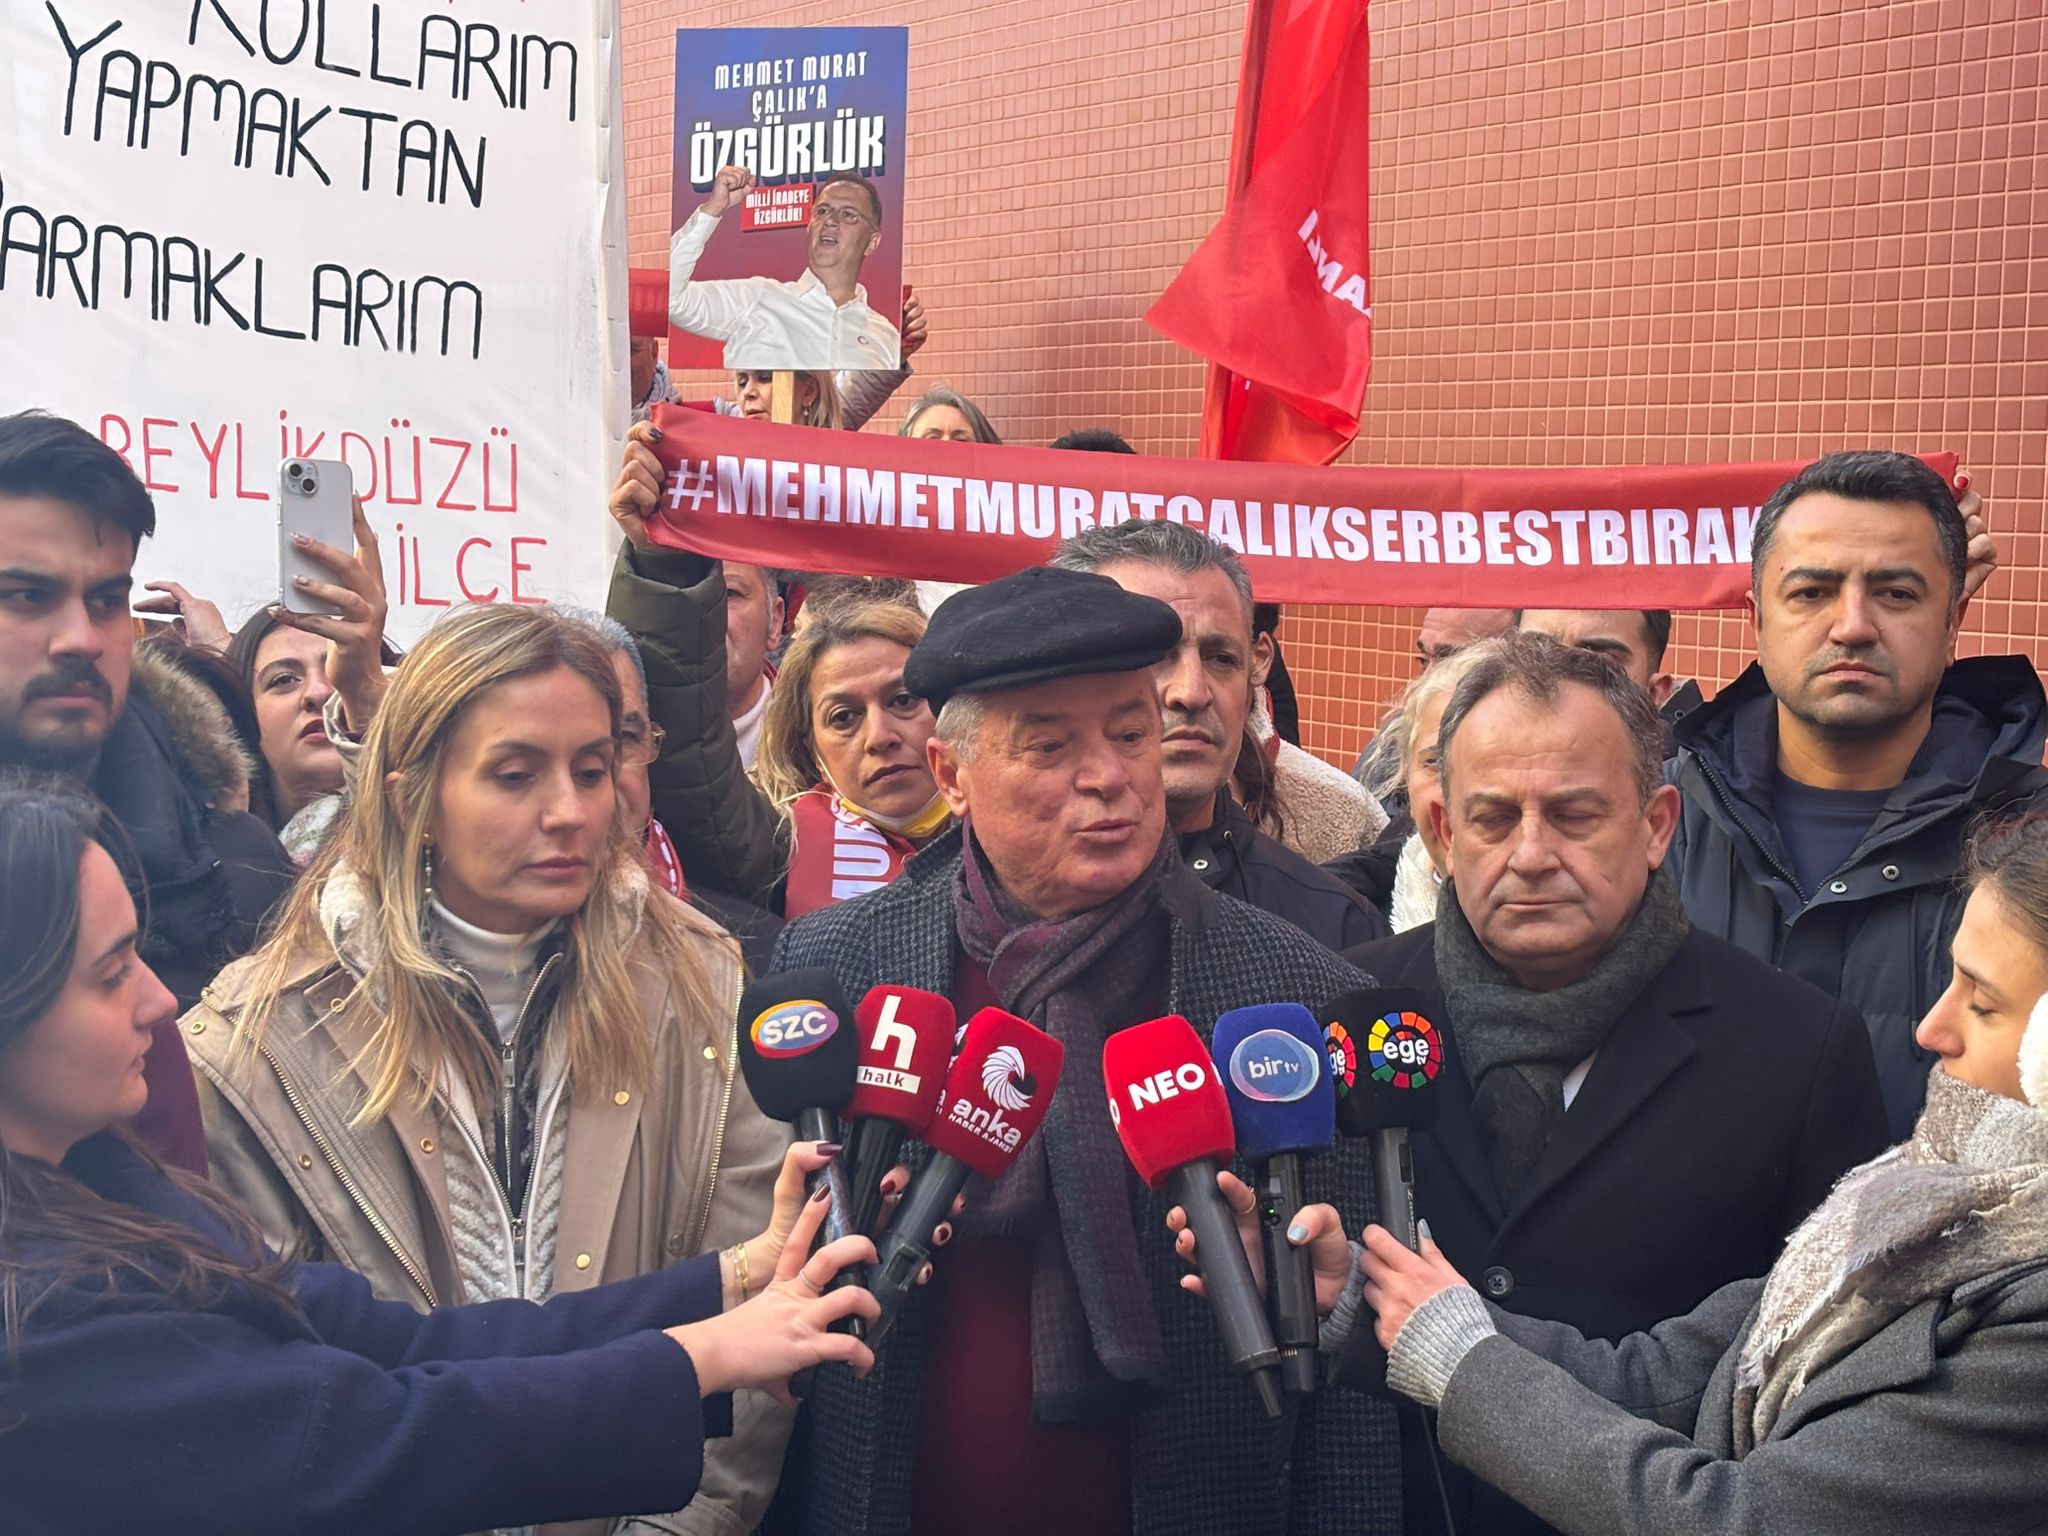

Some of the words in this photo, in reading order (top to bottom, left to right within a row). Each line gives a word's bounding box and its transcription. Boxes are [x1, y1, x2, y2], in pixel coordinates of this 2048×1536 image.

[714, 59, 795, 90] MEHMET
[802, 51, 868, 82] MURAT
[45, 0, 487, 208] YAPMAKTAN
[689, 108, 886, 187] ÖZGÜRLÜK
[0, 170, 483, 360] ARMAKLARIM
[762, 1010, 828, 1045] SZC
[1248, 1055, 1283, 1079] bir
[1284, 1062, 1300, 1074] tv
[1329, 1048, 1346, 1076] ge
[1382, 1038, 1430, 1064] ege
[862, 1067, 905, 1088] halk
[1127, 1062, 1206, 1112] NEO
[952, 1098, 1022, 1147] anka
